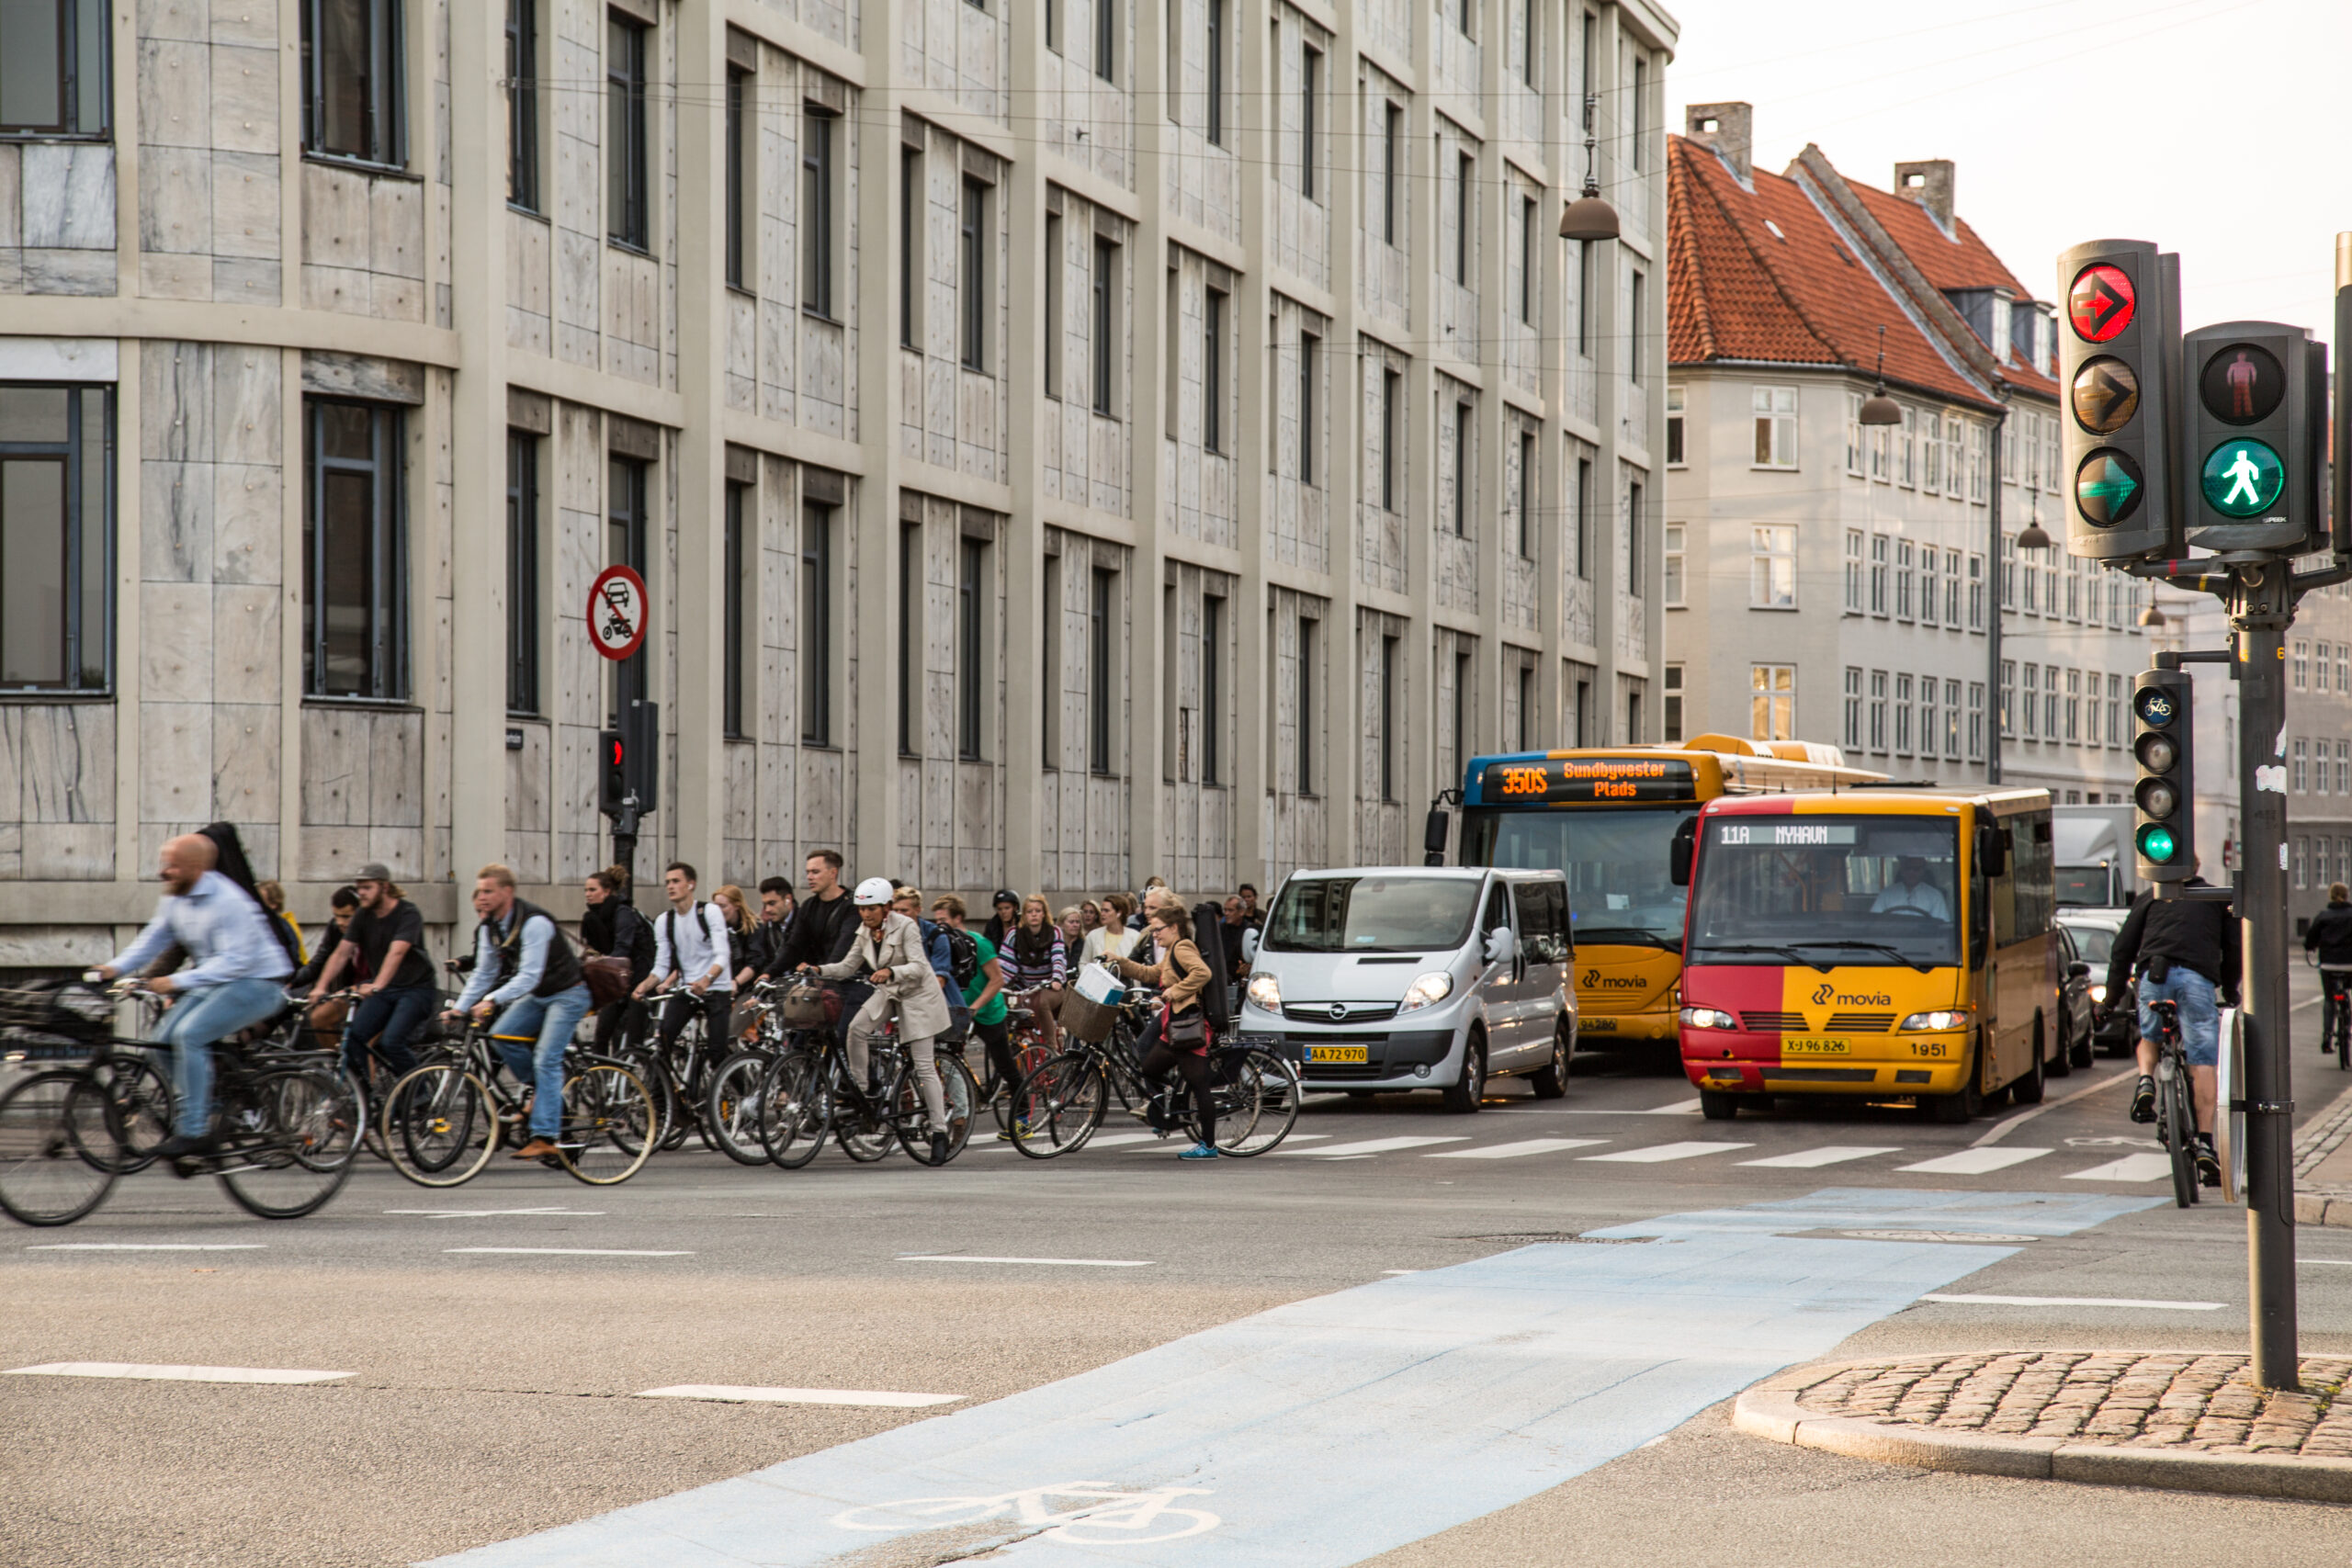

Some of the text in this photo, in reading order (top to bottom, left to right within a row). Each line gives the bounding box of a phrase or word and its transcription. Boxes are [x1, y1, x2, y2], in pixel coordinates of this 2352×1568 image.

[1564, 761, 1666, 781] Sundbyvester
[1502, 767, 1547, 794] 350S
[1594, 781, 1637, 796] Plads
[1721, 826, 1827, 844] 11A NYHAVN
[1603, 975, 1646, 987] movia
[1838, 991, 1892, 1006] movia
[1312, 1049, 1364, 1060] AA 72 970
[1911, 1043, 1947, 1056] 1951
